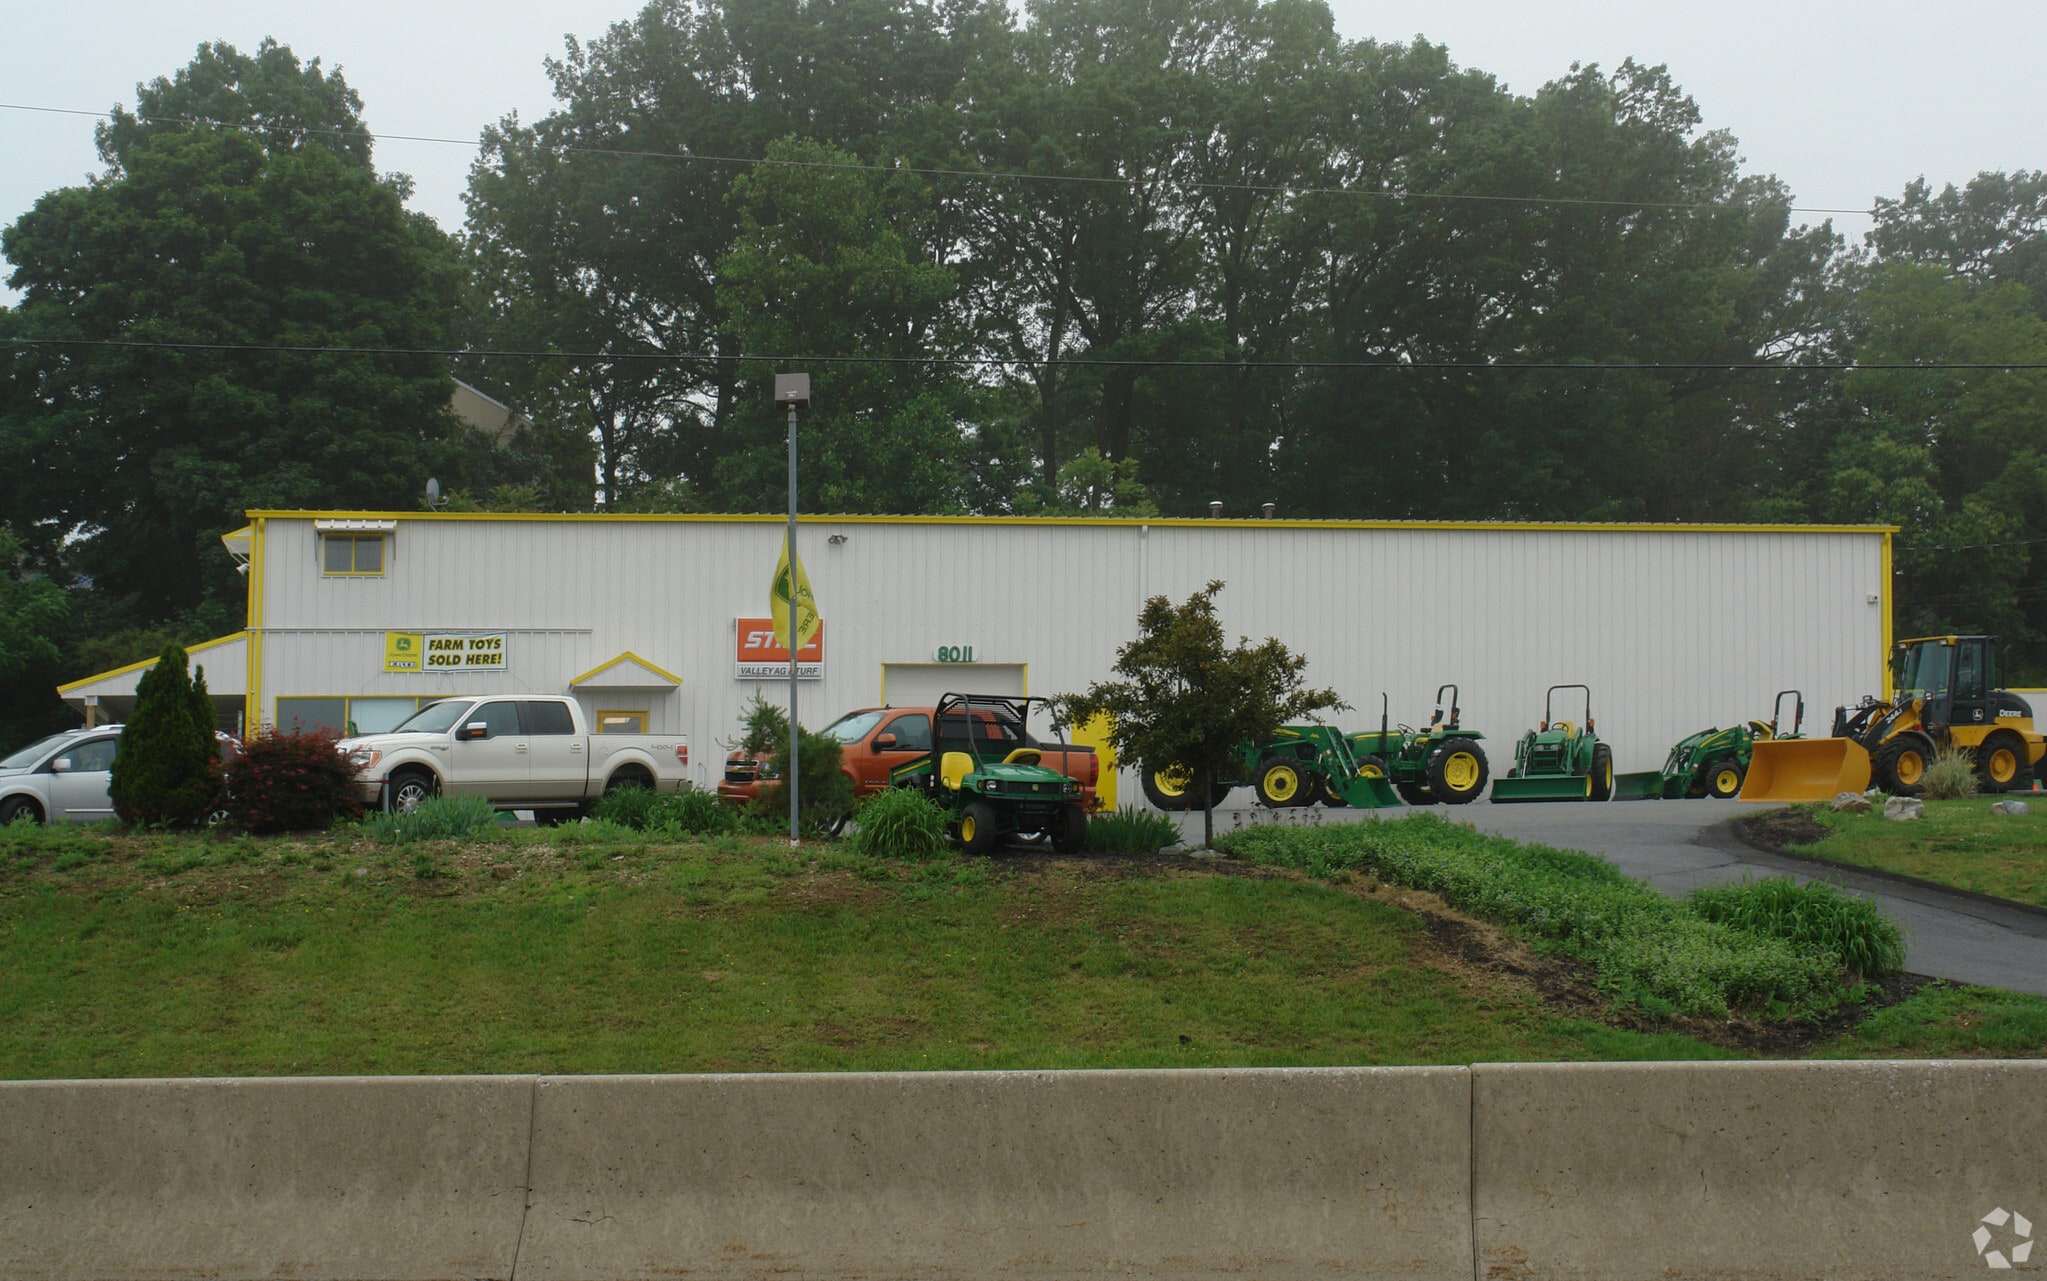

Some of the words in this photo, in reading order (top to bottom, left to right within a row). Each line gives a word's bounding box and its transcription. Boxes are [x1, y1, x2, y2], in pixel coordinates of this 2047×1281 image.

[796, 586, 814, 600] JOH
[429, 639, 464, 650] FARM
[469, 638, 501, 650] TOYS
[428, 655, 461, 666] SOLD
[465, 653, 502, 665] HERE!
[938, 646, 972, 662] 8011
[741, 667, 774, 675] VALLEY
[774, 667, 786, 675] AG
[796, 667, 818, 675] TURF
[1999, 709, 2022, 717] DEERE
